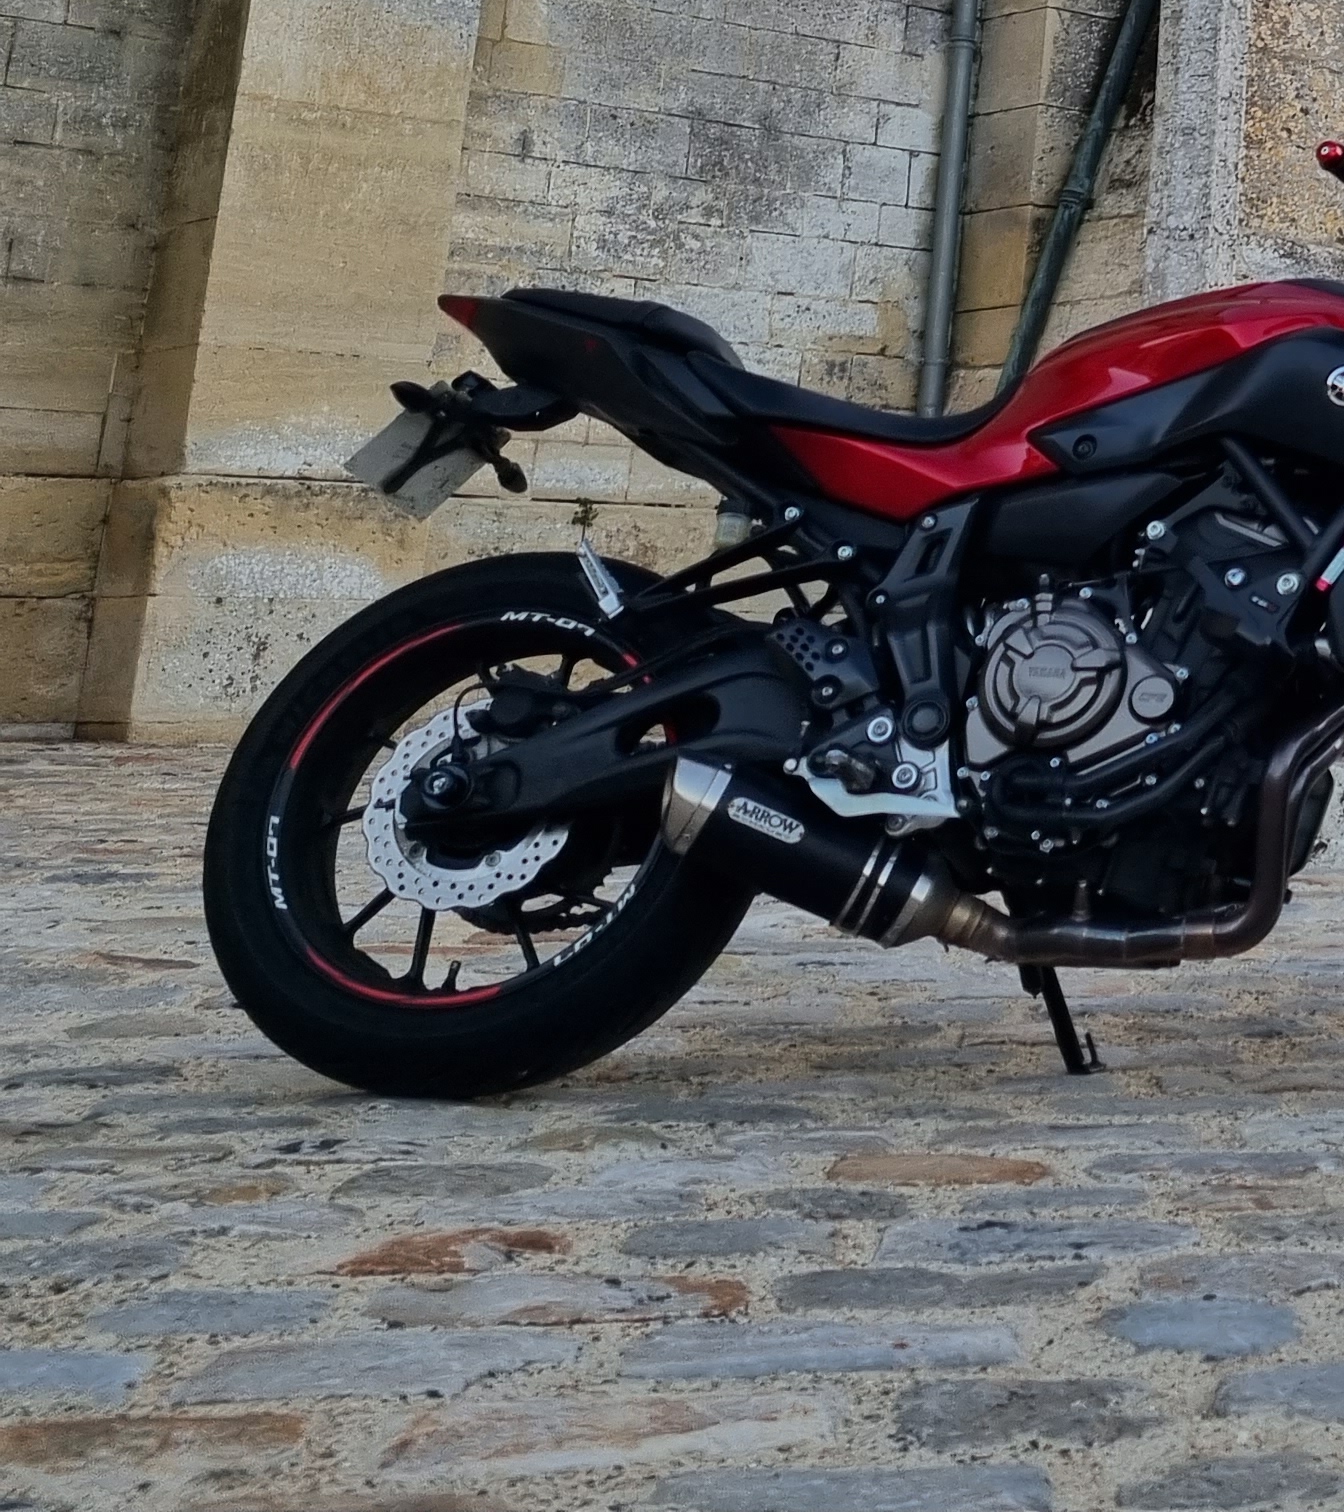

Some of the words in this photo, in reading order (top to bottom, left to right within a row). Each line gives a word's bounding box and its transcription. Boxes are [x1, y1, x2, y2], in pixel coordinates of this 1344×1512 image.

[500, 611, 596, 637] MT-07
[736, 800, 801, 835] ARROW
[266, 815, 288, 910] MT-07
[553, 883, 636, 967] MT-07
